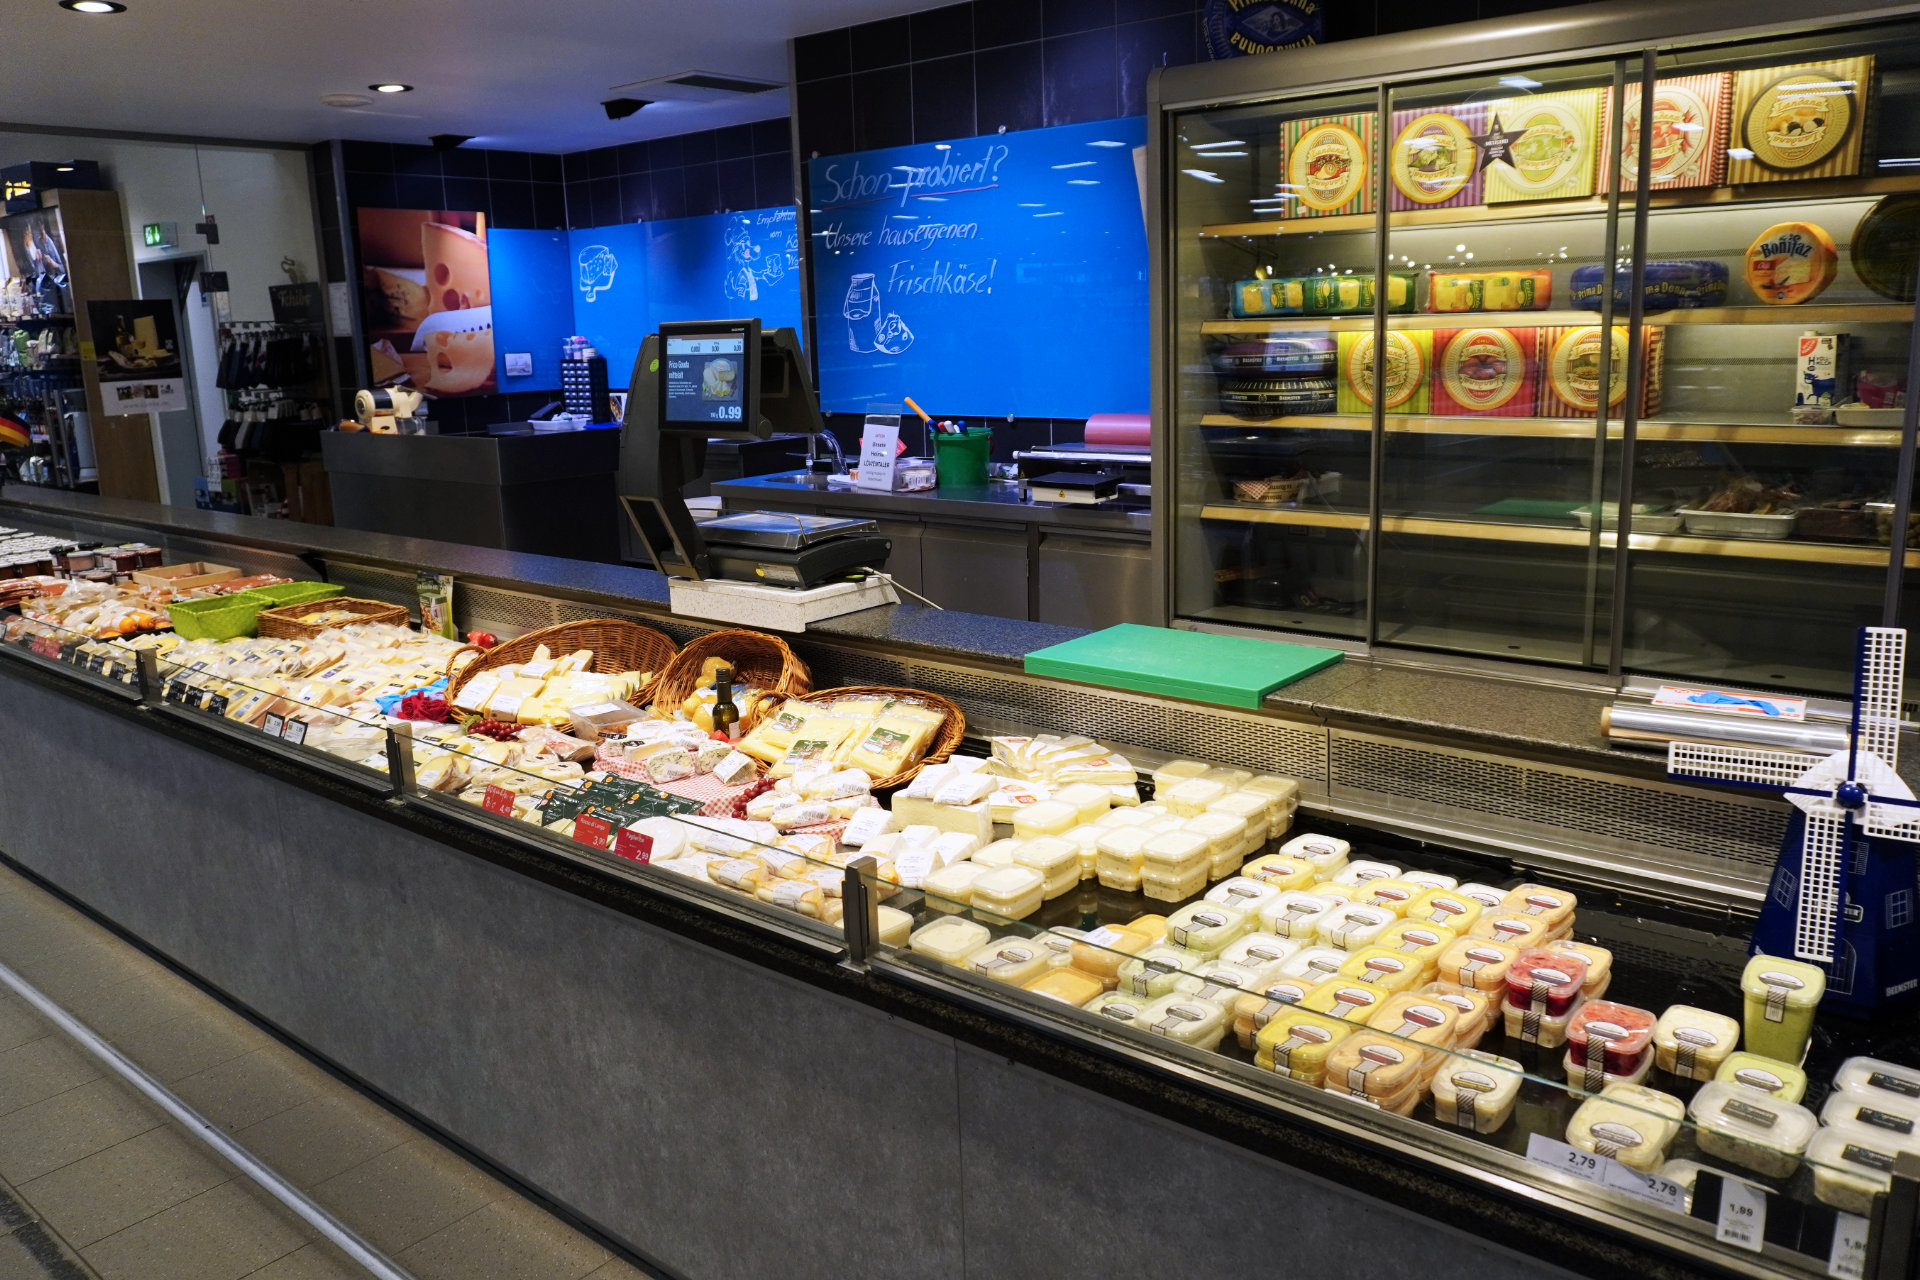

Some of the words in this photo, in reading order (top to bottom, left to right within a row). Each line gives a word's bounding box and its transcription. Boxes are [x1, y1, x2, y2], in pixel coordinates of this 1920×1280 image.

[1777, 98, 1823, 111] Landana
[821, 160, 892, 203] Schon
[901, 144, 1008, 208] probiert?
[825, 221, 873, 250] Unsere
[878, 215, 978, 250] hauseigenen
[887, 258, 998, 295] Frischkäse!
[1808, 356, 1815, 366] H
[718, 406, 742, 419] 0.99
[1885, 978, 1918, 997] BEEMSTER
[1567, 1151, 1597, 1169] 2,79
[1647, 1178, 1678, 1197] 2,79
[1729, 1202, 1754, 1217] 1,99
